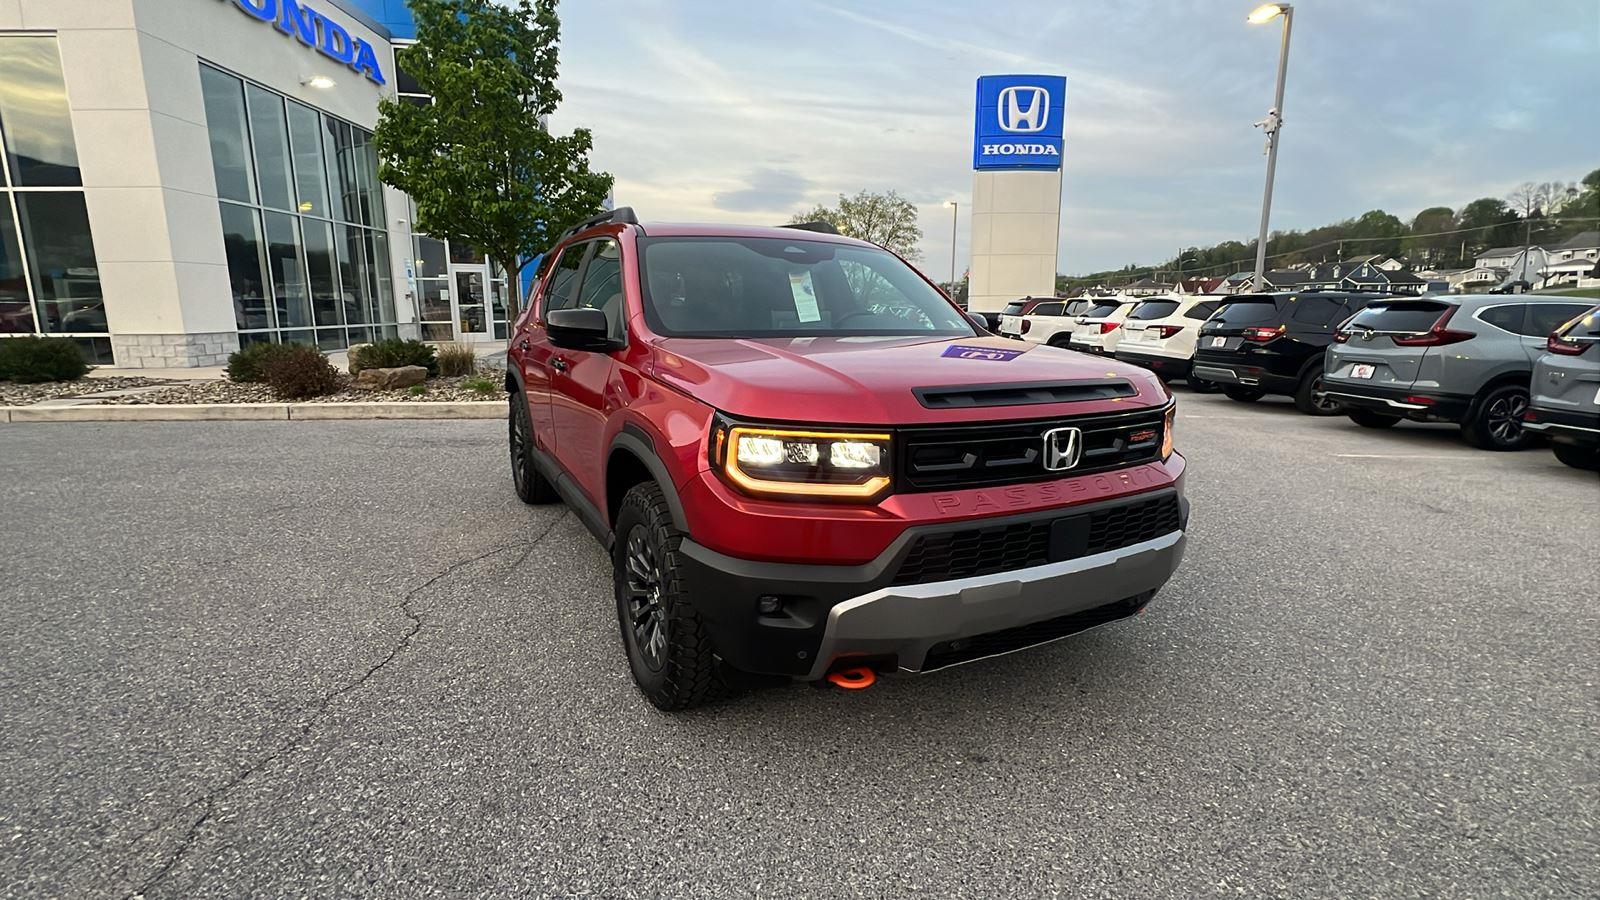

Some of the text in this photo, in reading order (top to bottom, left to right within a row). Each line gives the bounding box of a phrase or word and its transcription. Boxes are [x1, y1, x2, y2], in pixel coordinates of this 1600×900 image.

[233, 0, 386, 85] NDA
[982, 143, 1059, 155] HONDA
[932, 467, 1152, 515] PASSPORT
